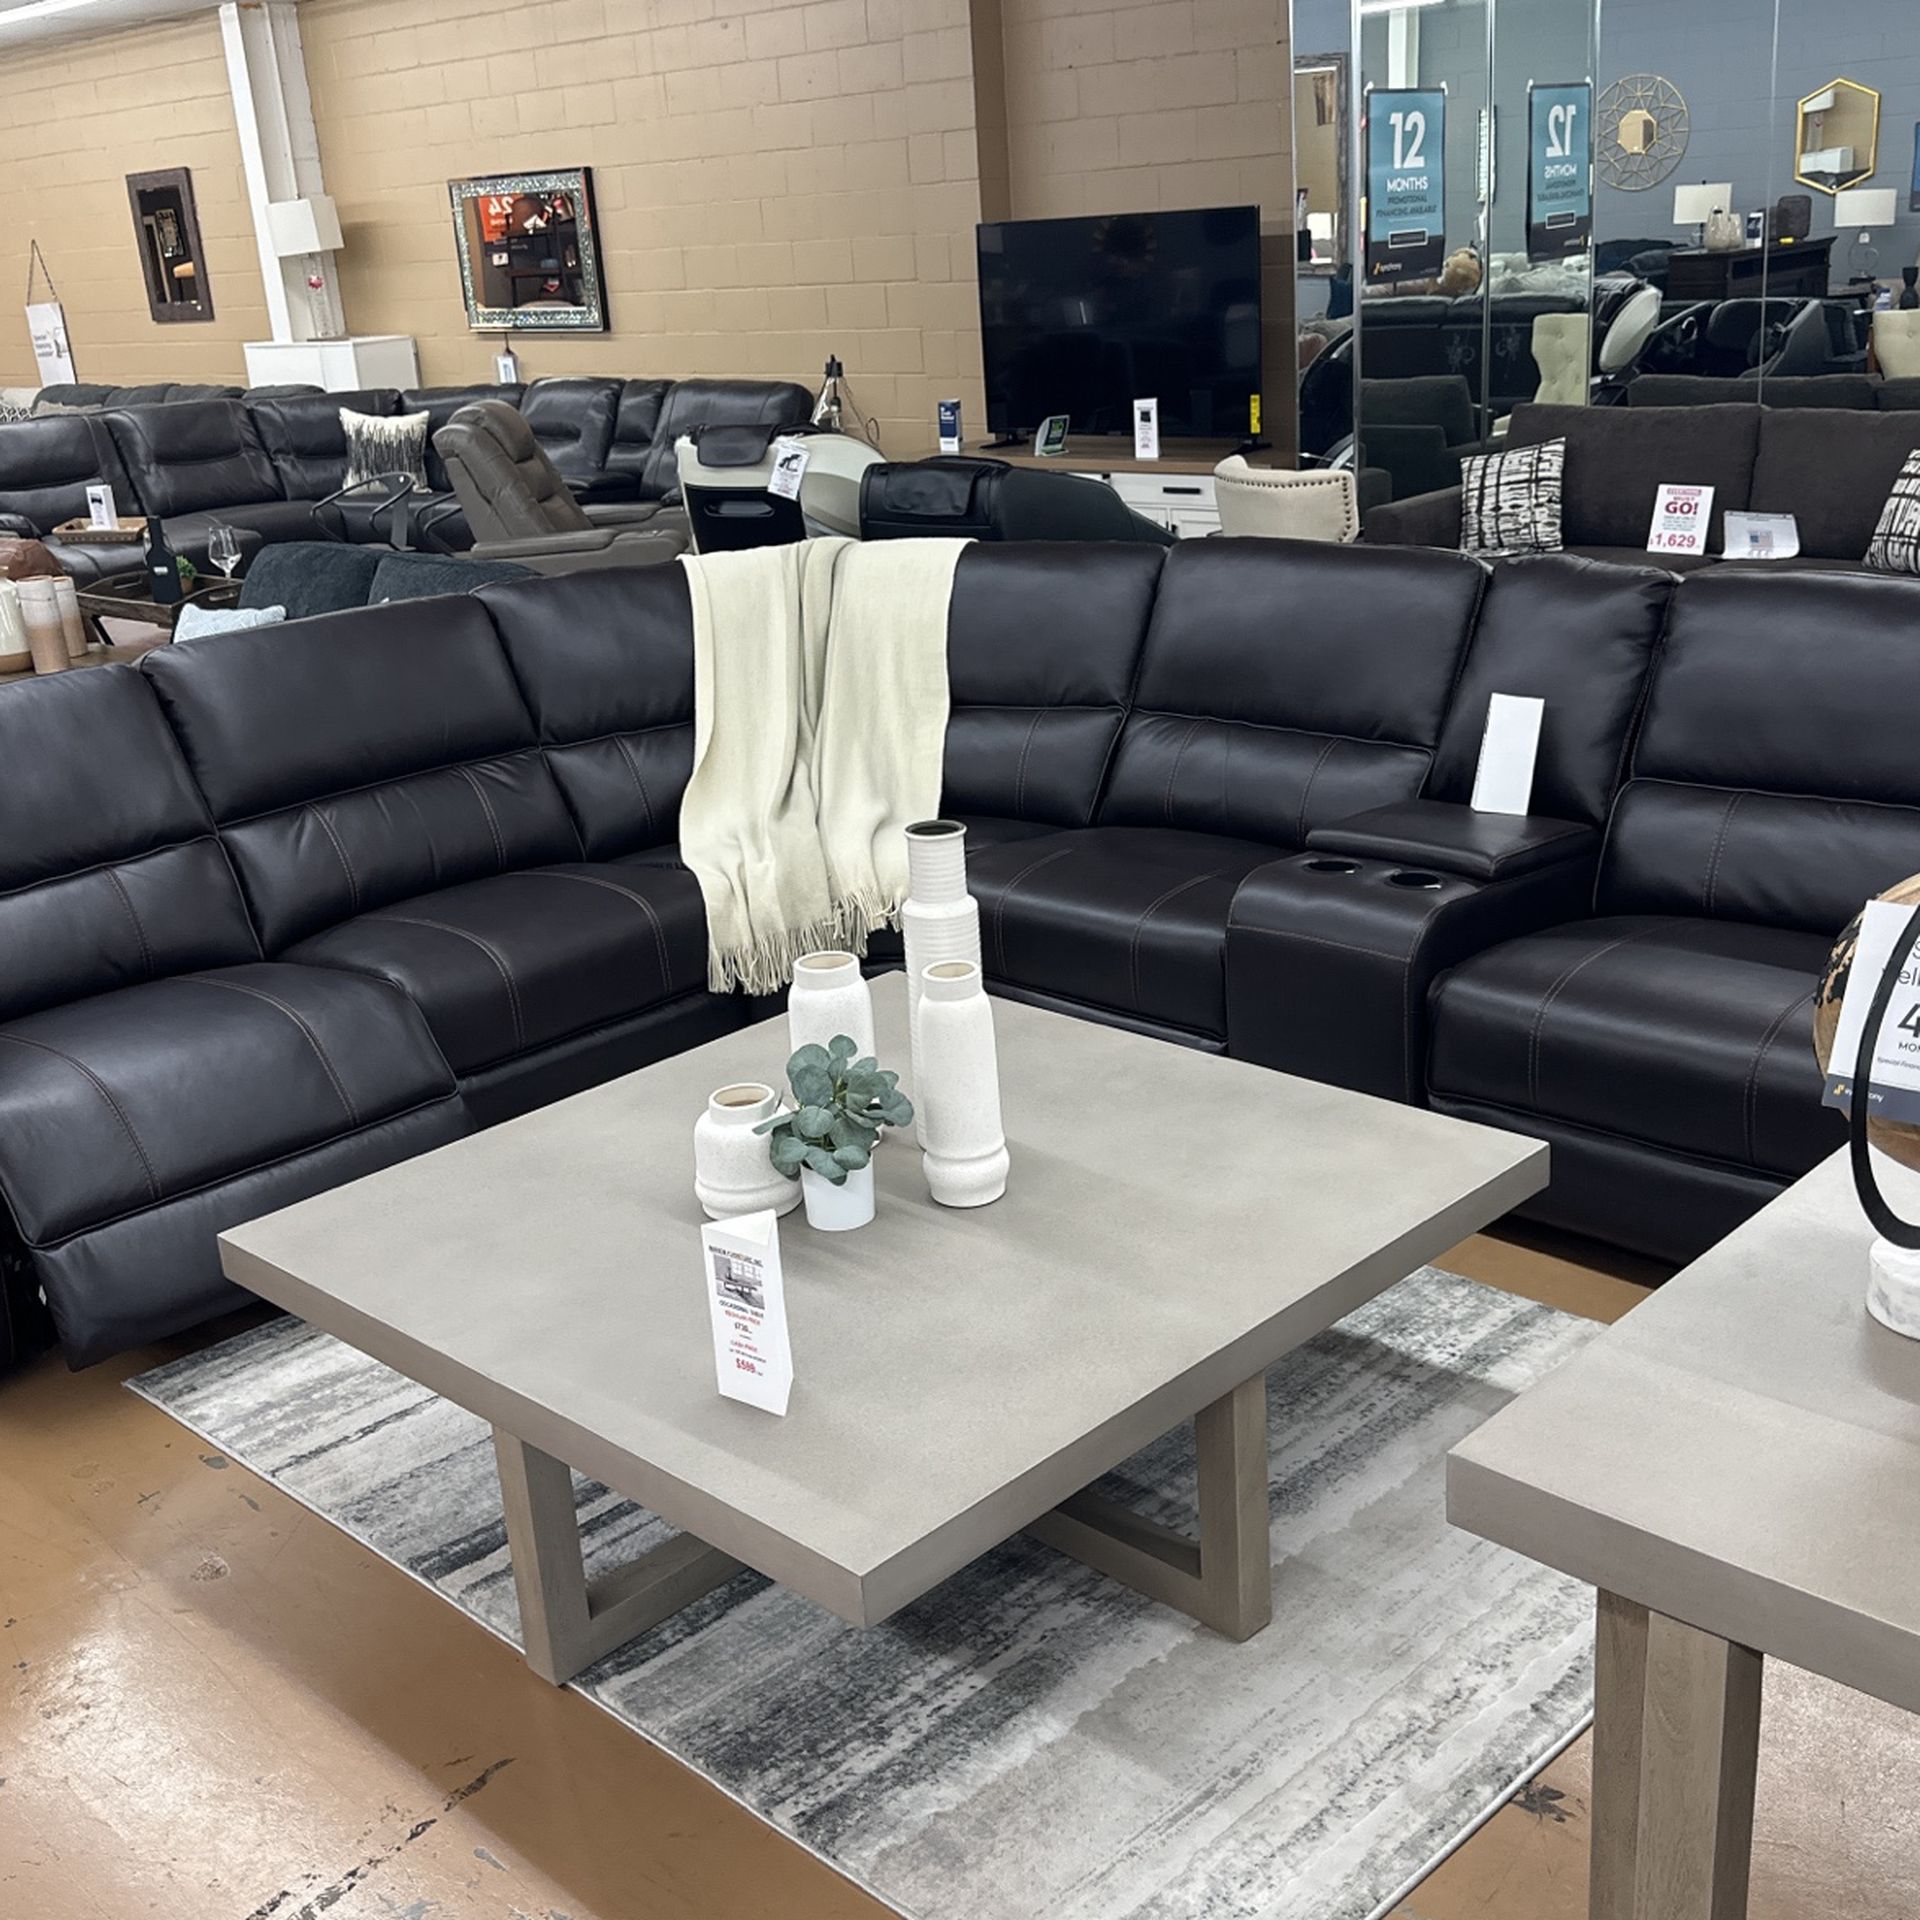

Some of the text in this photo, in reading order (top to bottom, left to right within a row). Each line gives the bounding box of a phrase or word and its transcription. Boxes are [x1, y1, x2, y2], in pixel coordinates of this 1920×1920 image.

[1389, 111, 1426, 169] 12
[1387, 176, 1428, 192] MONTHS
[1665, 501, 1699, 515] GO!
[1897, 1042, 1920, 1054] MO
